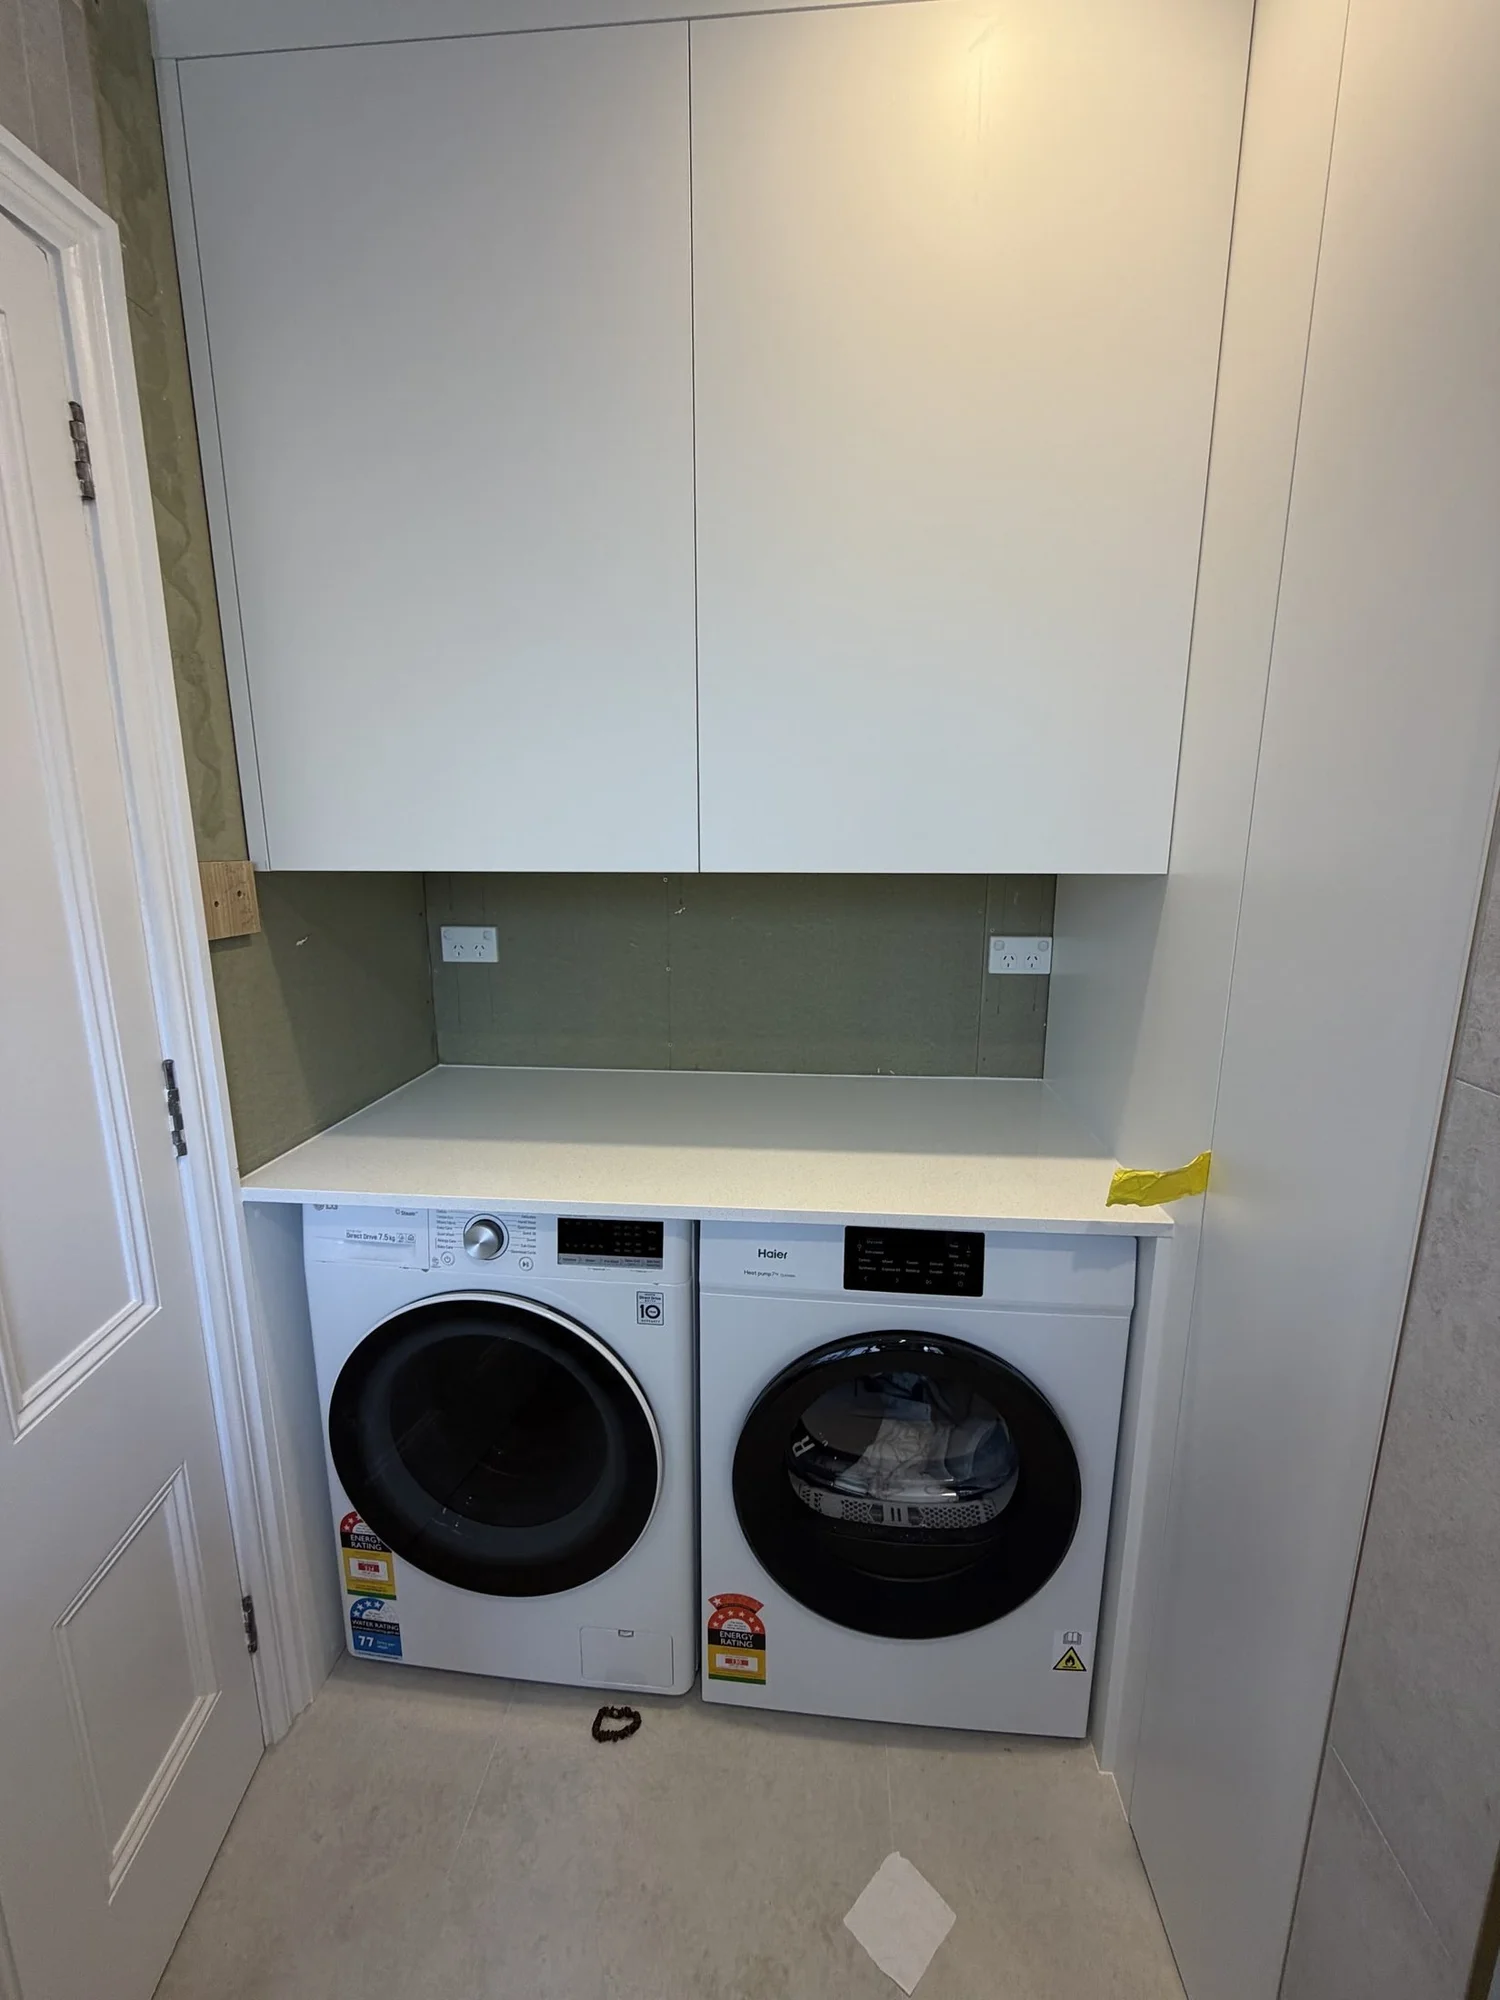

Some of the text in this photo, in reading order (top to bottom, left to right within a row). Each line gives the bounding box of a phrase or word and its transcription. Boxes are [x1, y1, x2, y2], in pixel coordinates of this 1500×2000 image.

[346, 1231, 362, 1239] Direct
[378, 1232, 388, 1241] 7.5
[758, 1248, 788, 1260] Haier
[640, 1304, 661, 1319] 10
[351, 1541, 382, 1551] RATING
[352, 1619, 374, 1628] WATER
[374, 1622, 399, 1631] RATING
[719, 1630, 754, 1641] ENERGY
[358, 1635, 374, 1648] 77
[720, 1638, 753, 1648] RATING
